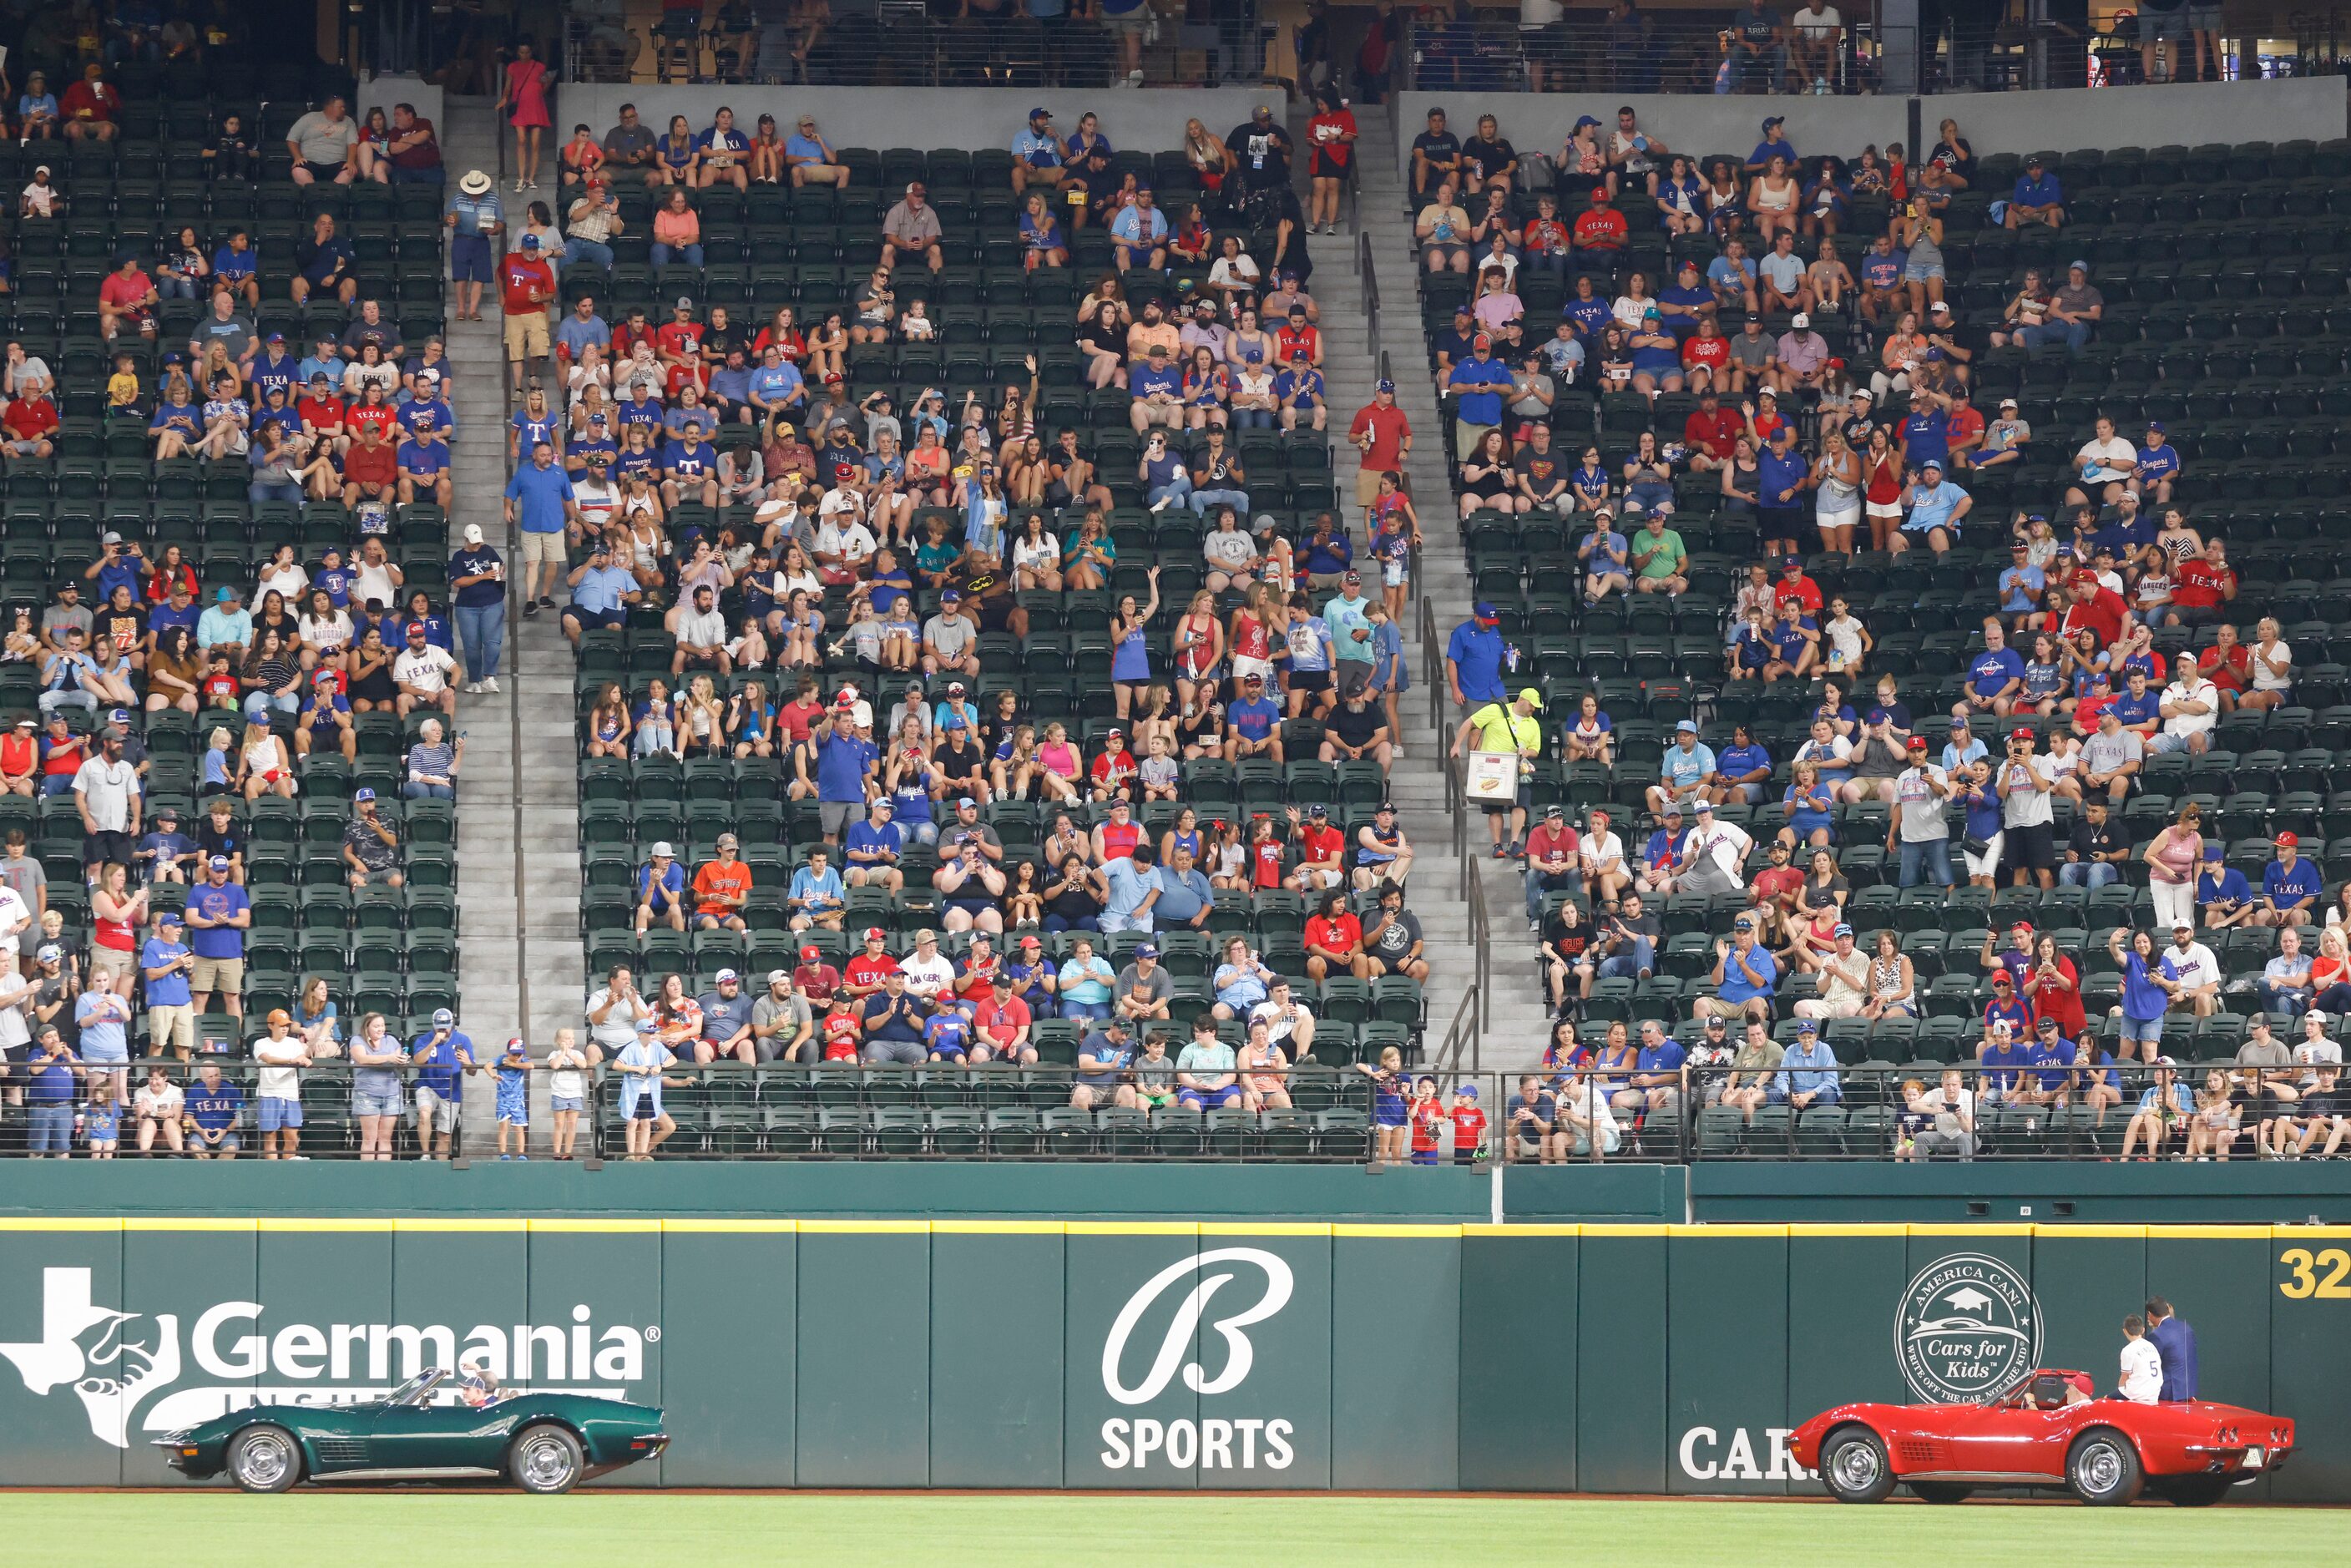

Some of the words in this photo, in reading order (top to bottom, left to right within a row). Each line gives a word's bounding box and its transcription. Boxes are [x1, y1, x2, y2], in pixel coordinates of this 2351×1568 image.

[1587, 221, 1614, 230] TEXAS
[513, 275, 523, 286] T
[1575, 308, 1602, 316] TEXAS
[1282, 337, 1310, 346] TEAS
[262, 375, 288, 386] TEXA
[1144, 382, 1172, 392] Rangers
[356, 411, 386, 419] TEXAS
[630, 415, 653, 423] TEXAS
[528, 423, 546, 442] T
[625, 458, 651, 467] RANGERS
[679, 459, 700, 474] T
[2141, 458, 2168, 470] Rangers
[2192, 574, 2224, 590] TEXAS
[428, 620, 439, 630] T
[407, 662, 442, 680] TEXAS
[2093, 746, 2123, 757] TEXAS
[1315, 847, 1324, 860] T
[2274, 884, 2303, 894] TEXAS
[856, 972, 886, 984] TEXA
[2035, 1059, 2061, 1067] TEXAS
[195, 1100, 230, 1112] TEXA
[2279, 1248, 2351, 1299] 32
[1915, 1266, 1984, 1307] AMERICA
[1990, 1272, 2022, 1308] CAN!
[1928, 1339, 1972, 1356] Cars
[1974, 1340, 2006, 1359] for
[1907, 1344, 1924, 1378] WRITE
[1923, 1376, 1941, 1393] OFF
[1941, 1388, 1960, 1402] THE
[2002, 1367, 2020, 1388] THE
[2150, 1360, 2158, 1378] 5
[1100, 1418, 1294, 1469] SPORTS
[1679, 1426, 1823, 1481] CAR
